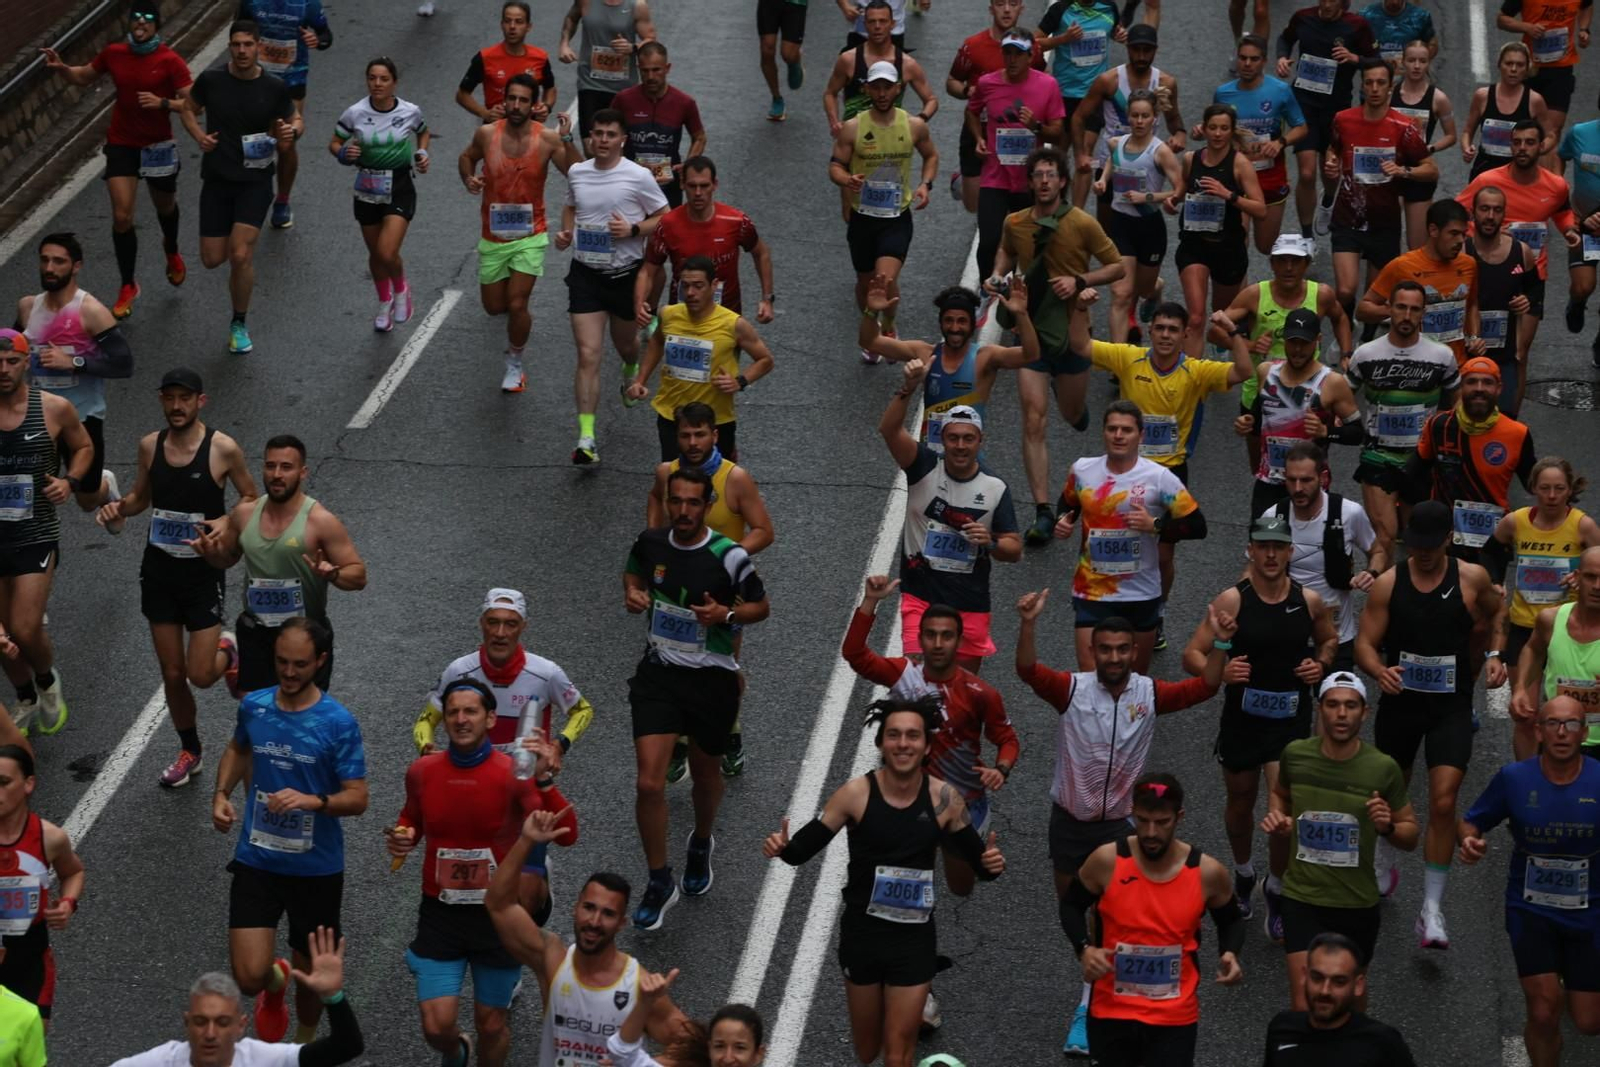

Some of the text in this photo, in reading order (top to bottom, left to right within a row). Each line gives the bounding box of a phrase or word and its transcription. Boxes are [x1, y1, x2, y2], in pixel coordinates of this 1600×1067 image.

[1428, 312, 1455, 326] 3097
[670, 346, 700, 363] 3148
[1383, 416, 1414, 429] 1842
[1145, 425, 1168, 441] 167
[1461, 511, 1493, 529] 1509
[159, 522, 191, 539] 2021
[932, 535, 966, 553] 2748
[1095, 540, 1128, 555] 1584
[1520, 541, 1571, 553] WEST 4
[255, 591, 290, 606] 2338
[659, 614, 693, 635] 2927
[1406, 664, 1442, 683] 1882
[1251, 693, 1288, 711] 2826
[261, 809, 299, 831] 3025
[1306, 824, 1344, 843] 2415
[1524, 827, 1594, 838] FUENTES
[450, 863, 478, 880] 297
[884, 881, 920, 900] 3068
[1124, 957, 1165, 976] 2741
